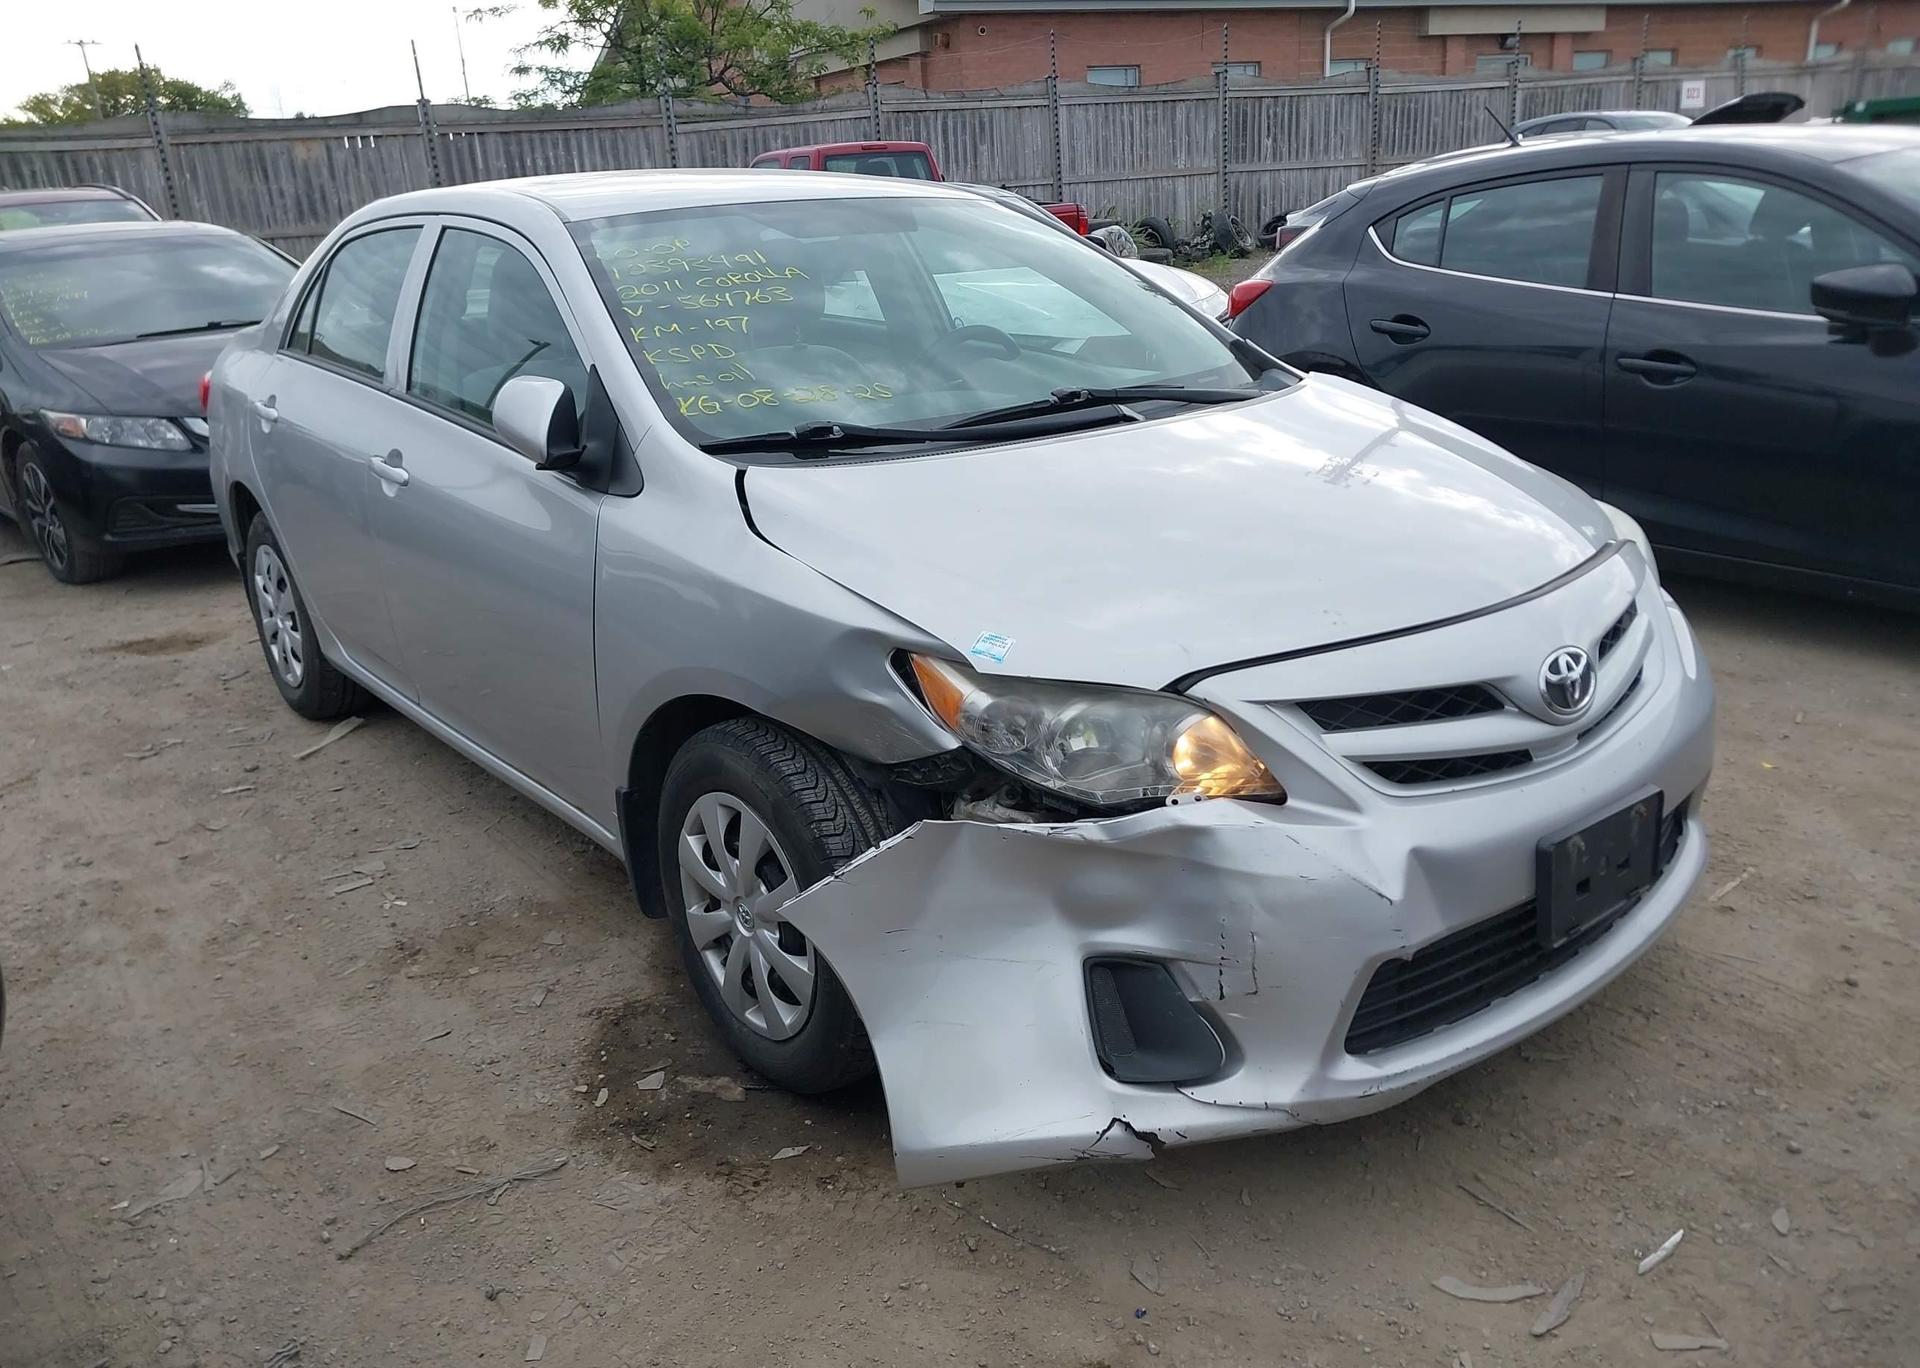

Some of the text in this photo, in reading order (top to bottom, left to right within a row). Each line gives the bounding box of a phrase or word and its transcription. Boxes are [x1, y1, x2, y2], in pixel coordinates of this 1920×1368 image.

[616, 266, 810, 299] 2011 COROLLA
[642, 343, 736, 365] KSPD
